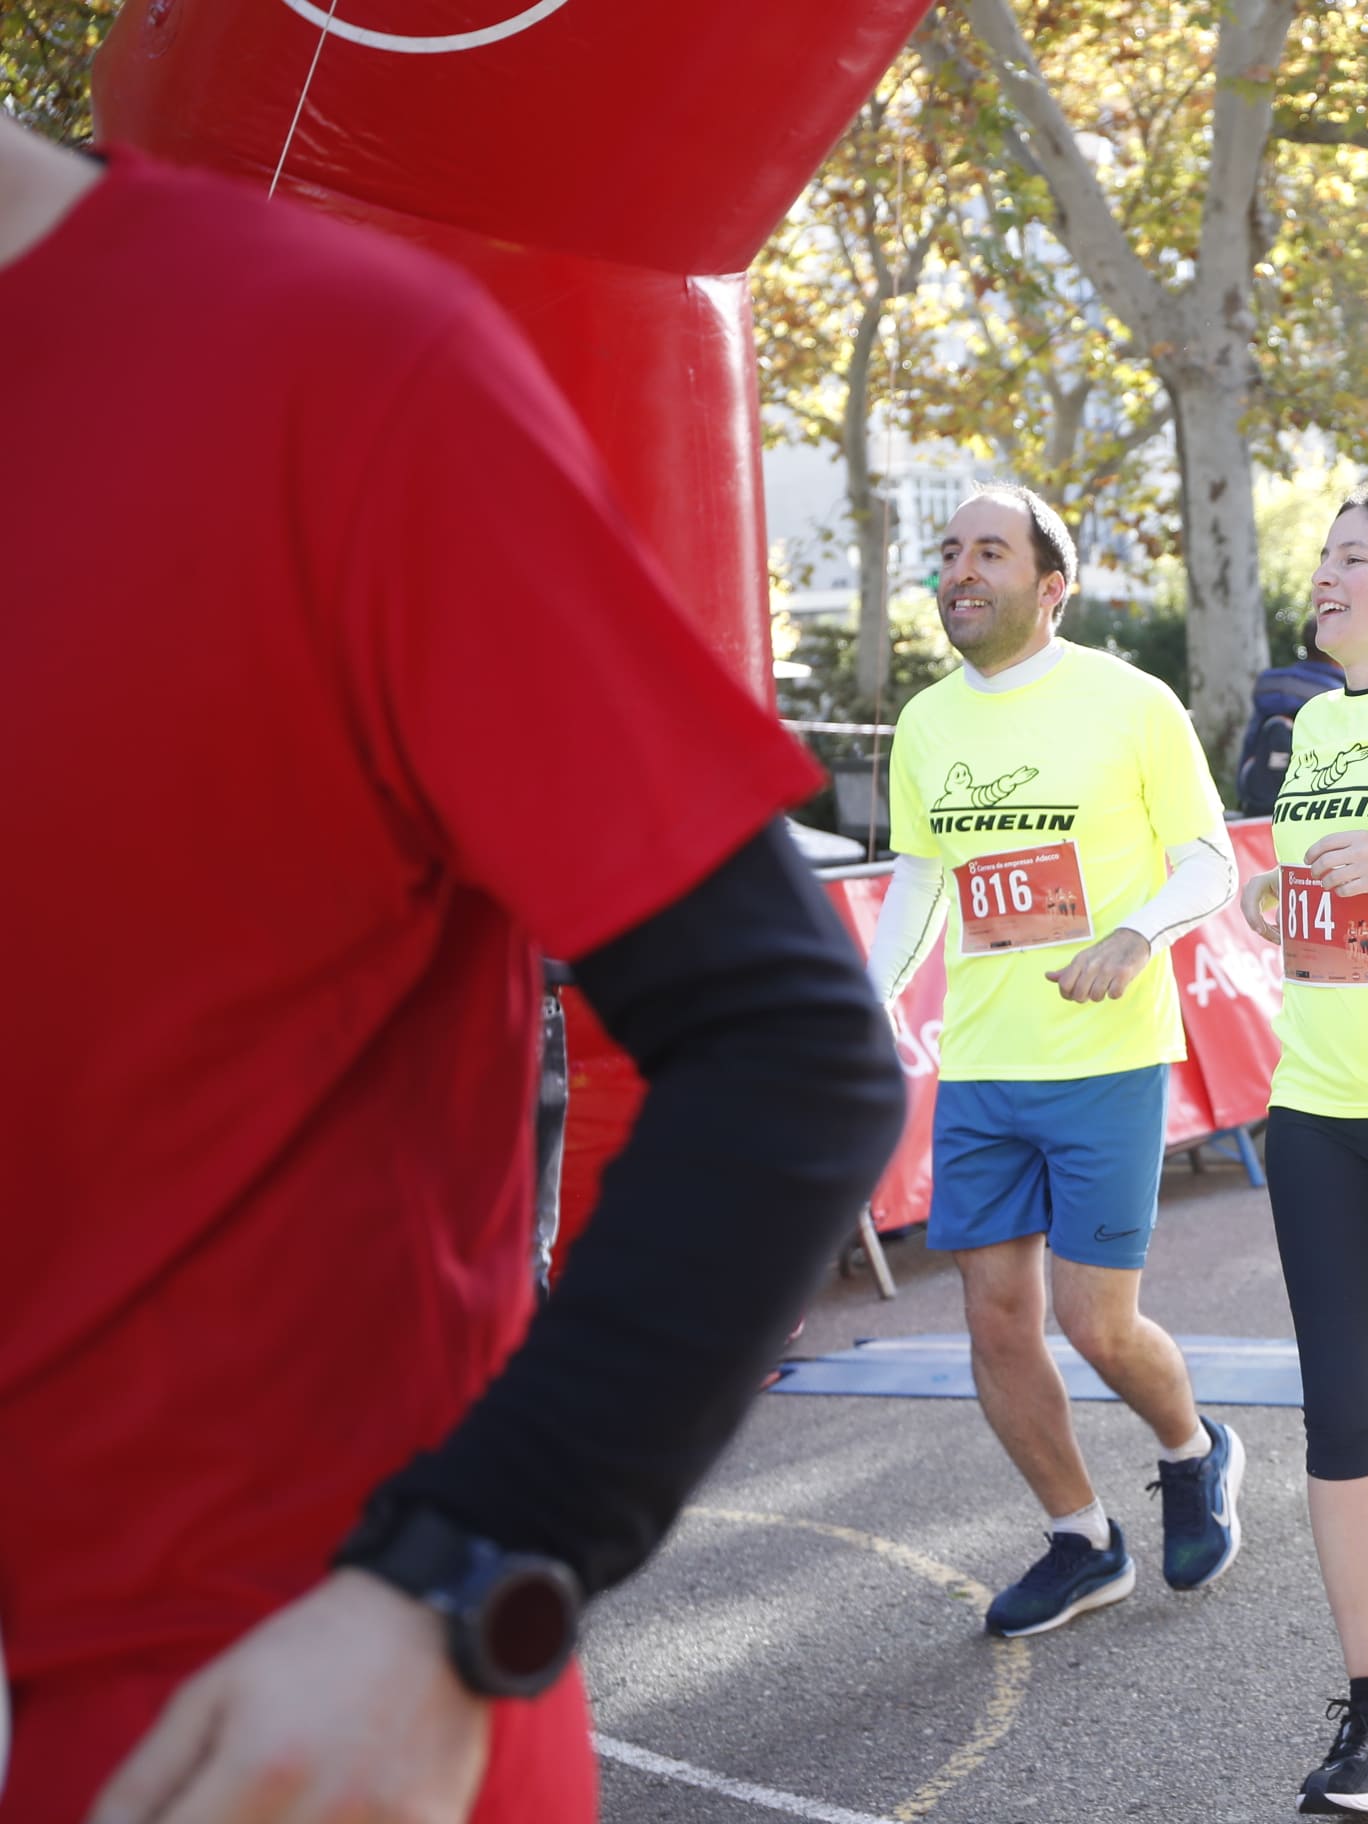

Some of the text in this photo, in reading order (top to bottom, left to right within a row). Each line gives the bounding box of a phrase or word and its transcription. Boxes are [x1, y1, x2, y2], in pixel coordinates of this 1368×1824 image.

[929, 813, 1076, 835] MICHELIN
[970, 869, 1033, 919] 816
[1288, 888, 1336, 941] 814
